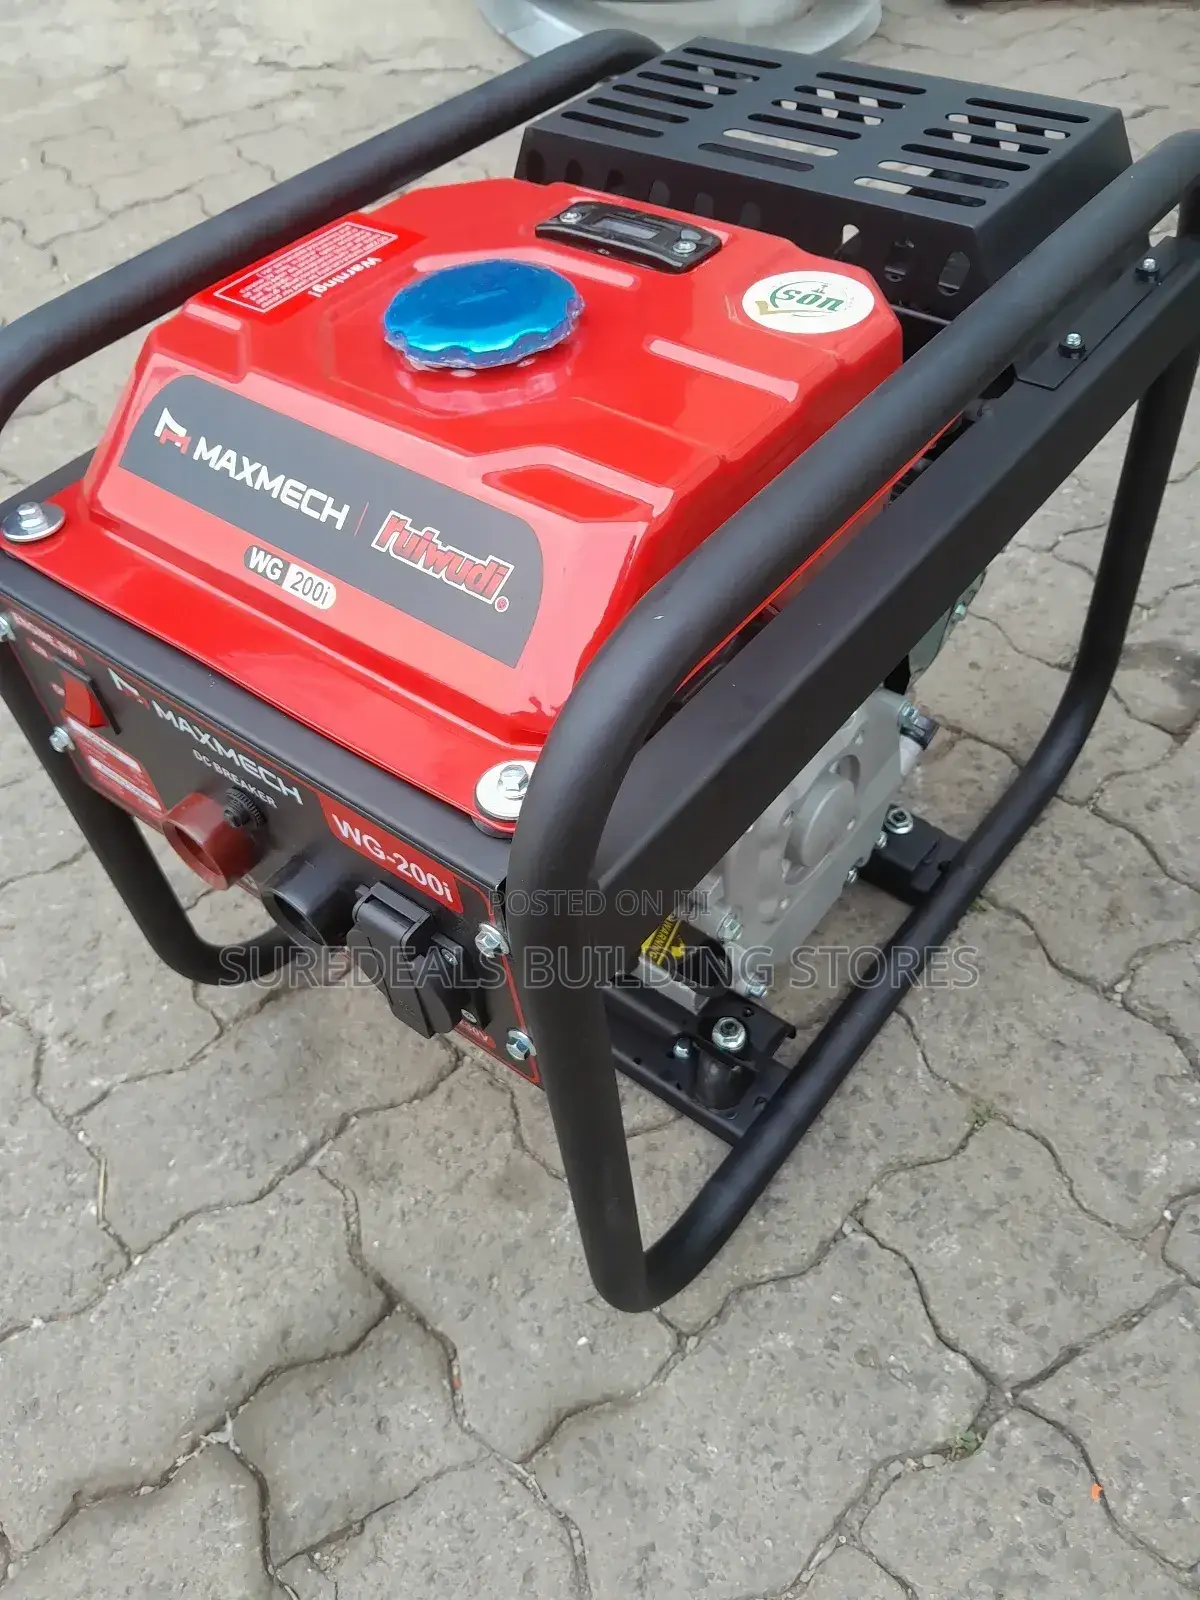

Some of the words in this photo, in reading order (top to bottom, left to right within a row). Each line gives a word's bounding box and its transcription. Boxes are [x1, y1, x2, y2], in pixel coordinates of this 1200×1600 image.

[308, 257, 382, 297] Warning!
[192, 436, 350, 530] MAXMECH
[248, 547, 284, 580] WG
[290, 571, 331, 605] 200i
[152, 700, 303, 805] MAXMECH
[193, 749, 213, 767] DC
[213, 761, 277, 808] BREAKER
[332, 813, 453, 902] WG-200i
